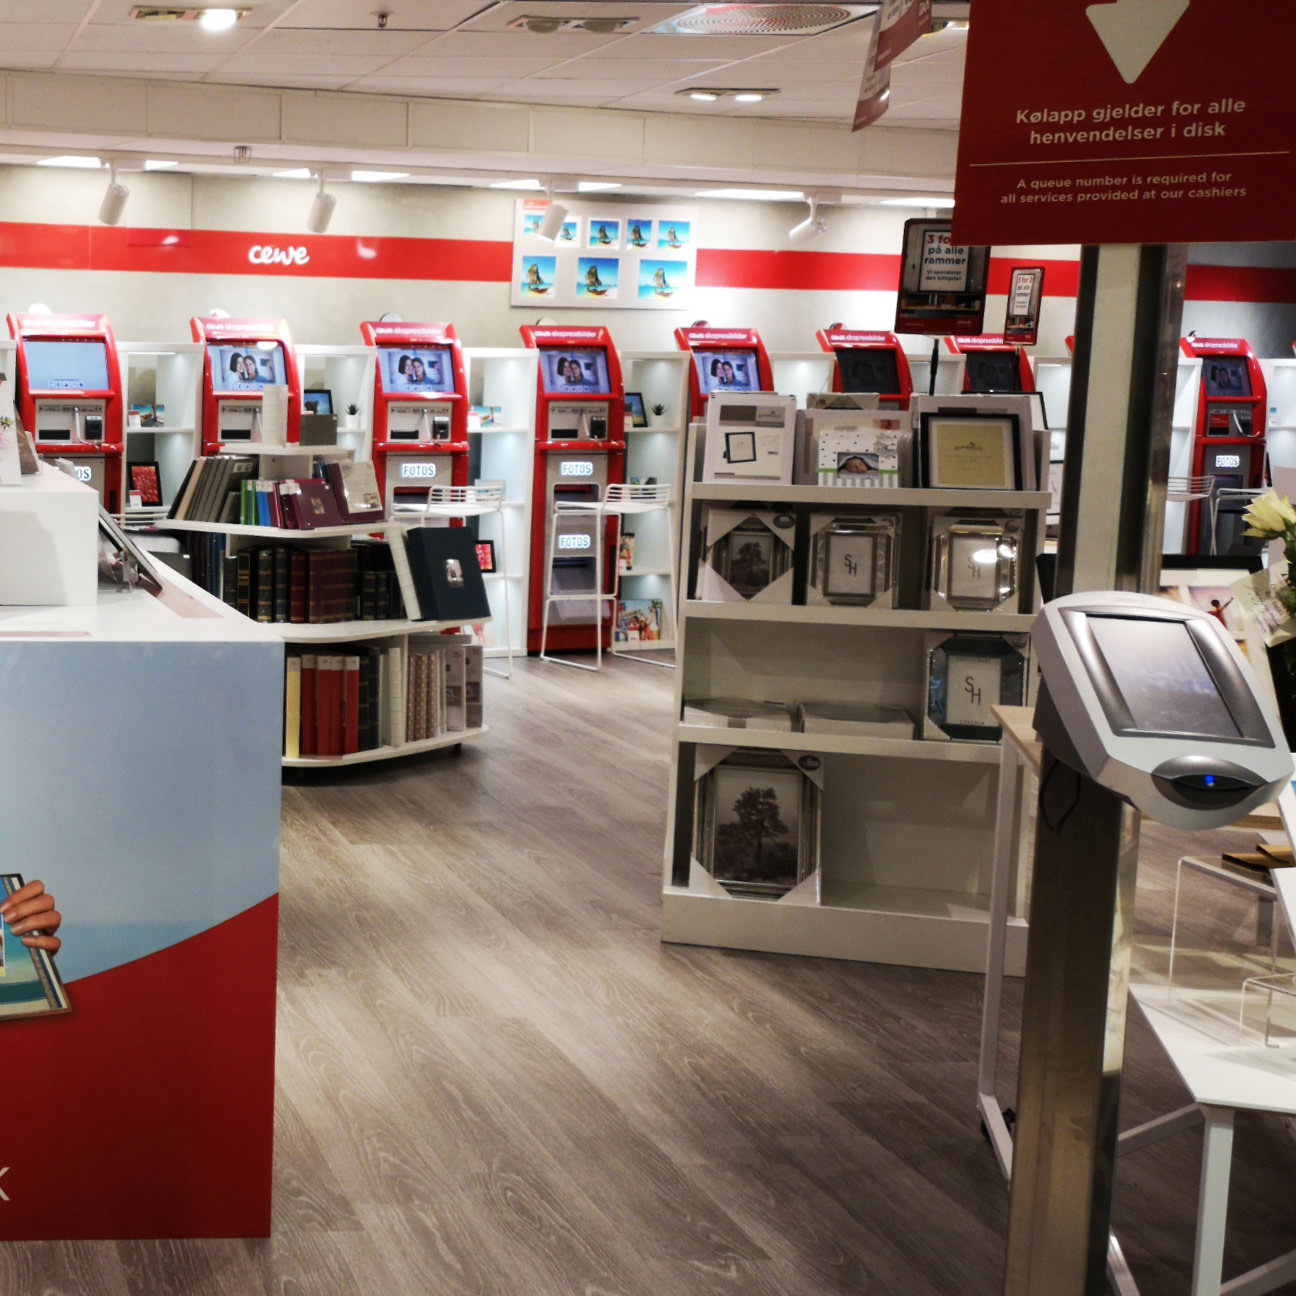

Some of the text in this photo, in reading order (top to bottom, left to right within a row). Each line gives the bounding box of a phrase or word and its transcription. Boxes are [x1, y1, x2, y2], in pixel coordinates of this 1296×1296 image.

[1016, 98, 1246, 125] Kølapp gjelder for alle
[1030, 121, 1226, 145] henvendelser i disk
[1016, 172, 1232, 190] A queue number is required for
[1001, 187, 1247, 204] all services provided at our cashiers
[927, 234, 951, 244] 3 fo
[248, 245, 310, 265] cewe
[928, 246, 964, 255] på alle
[924, 257, 966, 265] rammer
[1217, 456, 1239, 466] FOTOS
[403, 465, 435, 477] FOTOS
[563, 463, 591, 475] FOTOS
[560, 536, 588, 548] FOTOS
